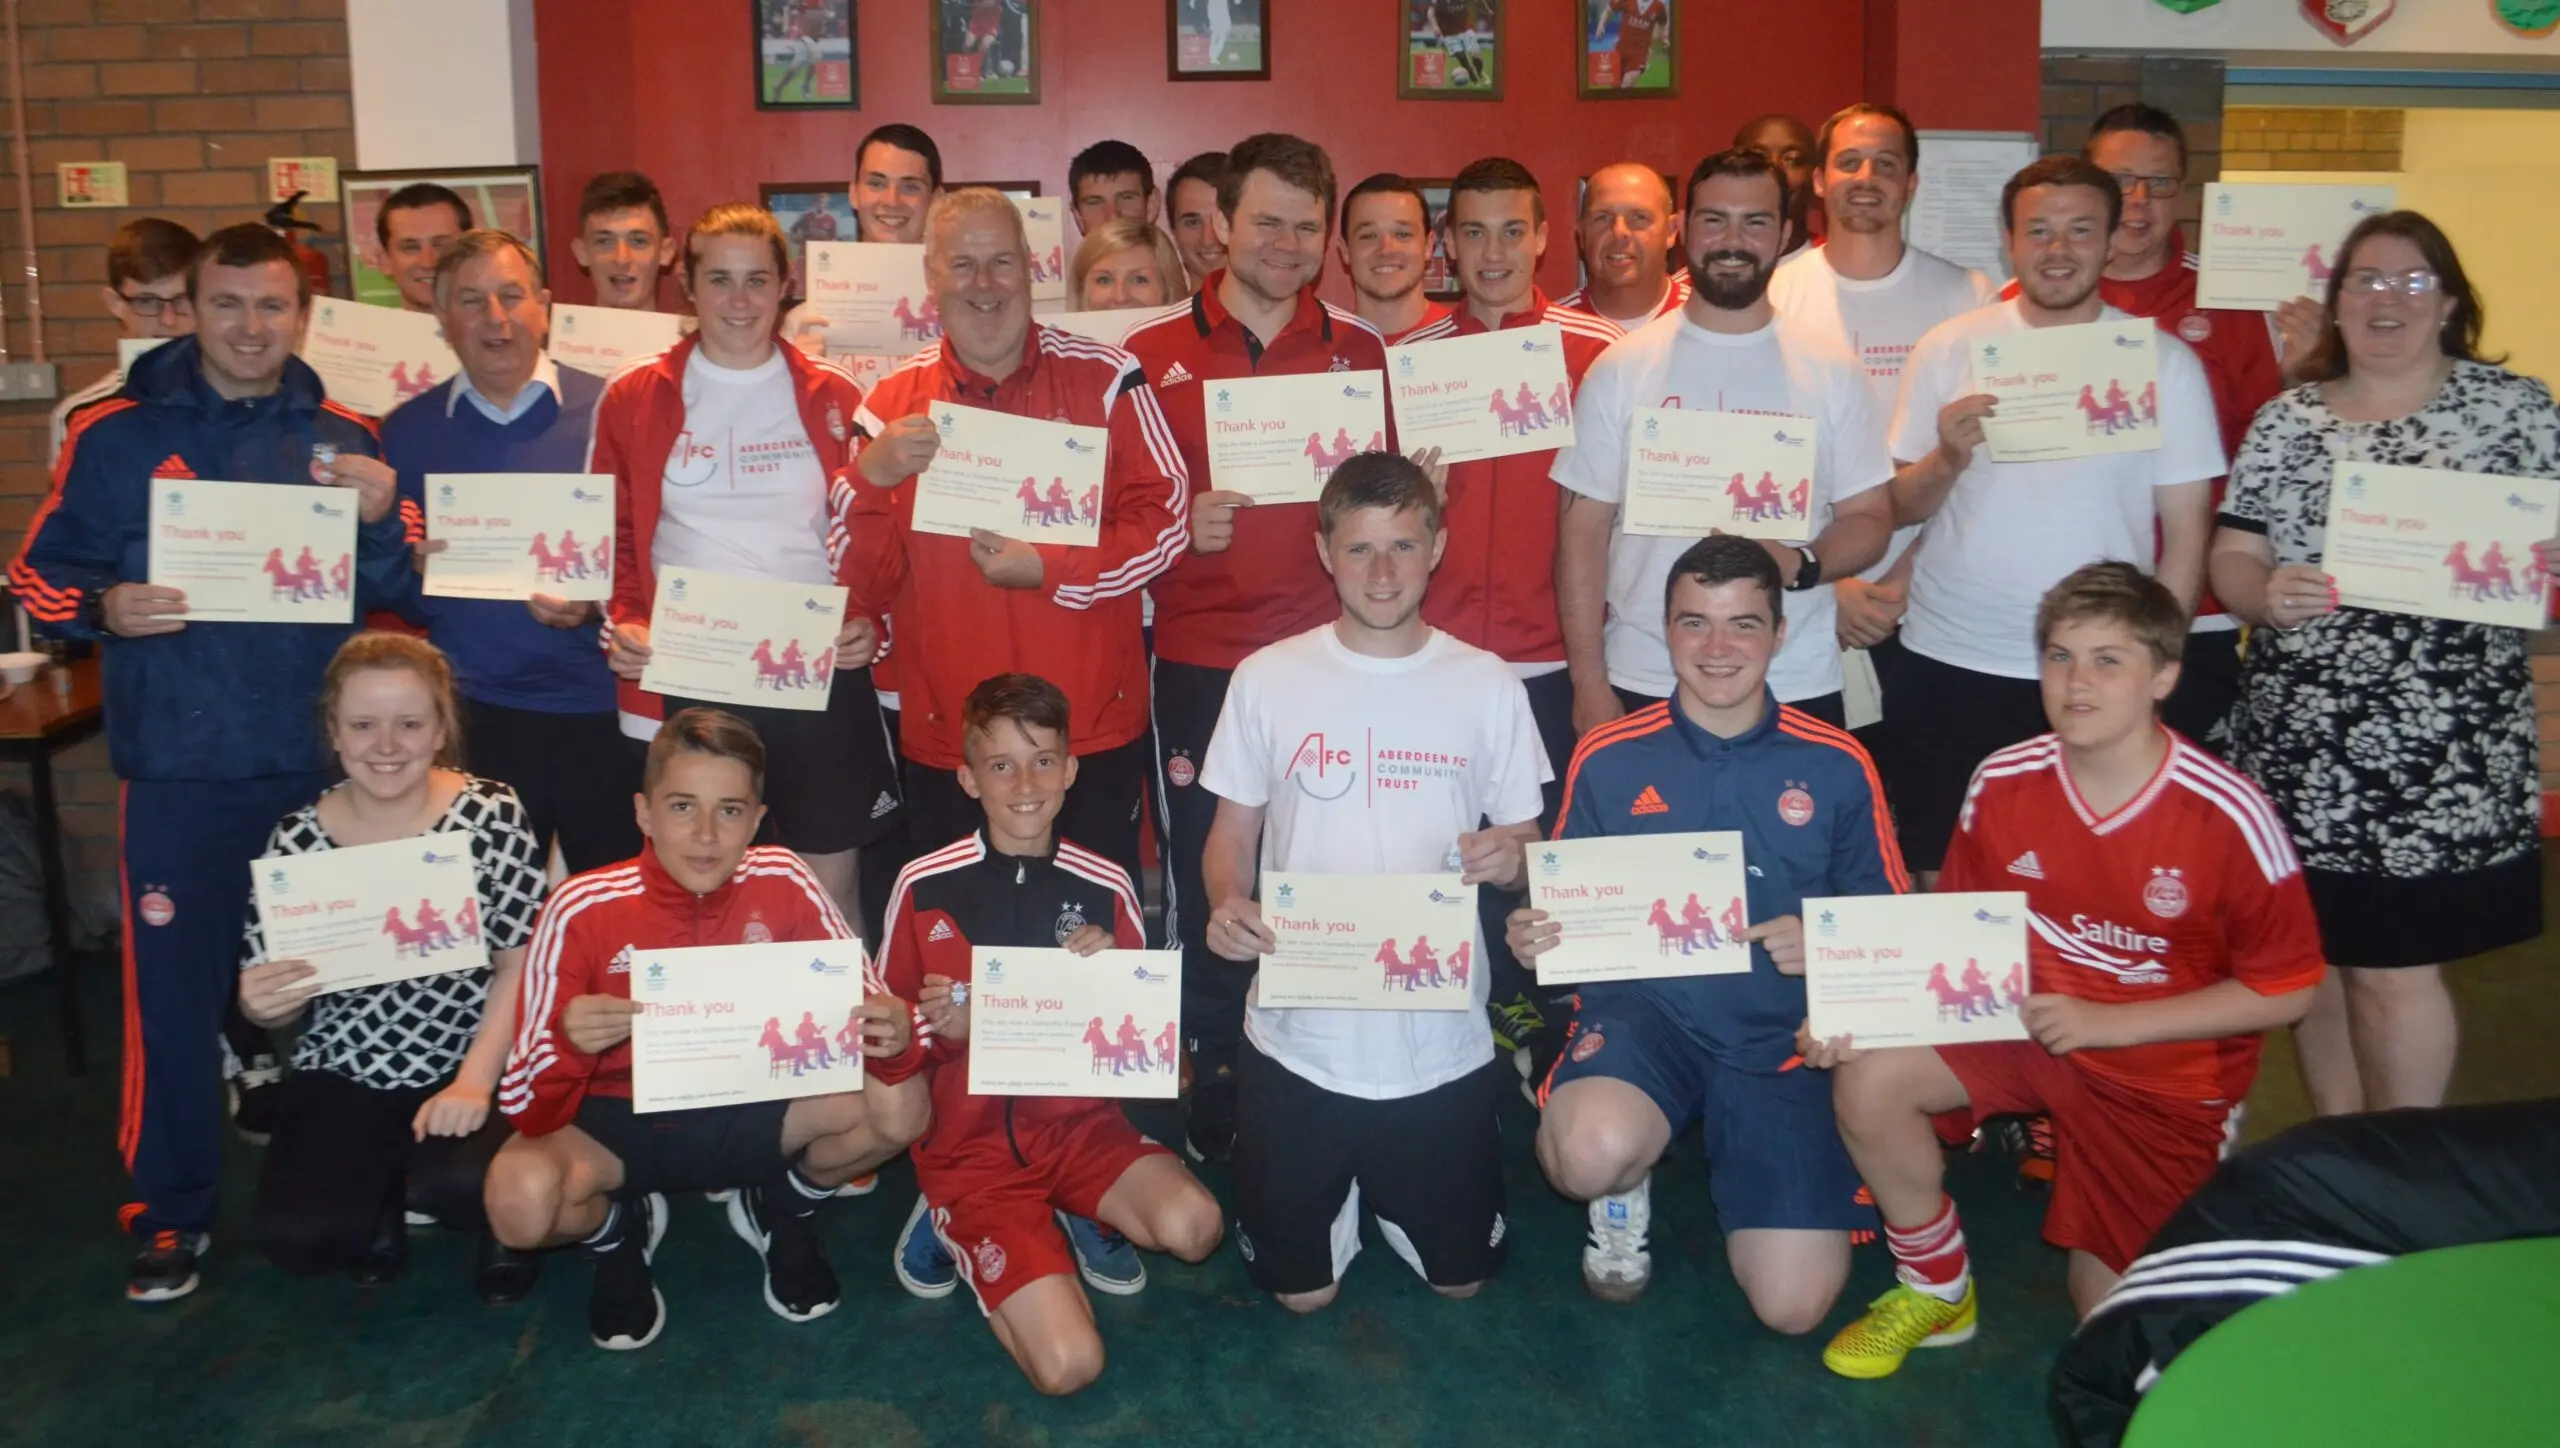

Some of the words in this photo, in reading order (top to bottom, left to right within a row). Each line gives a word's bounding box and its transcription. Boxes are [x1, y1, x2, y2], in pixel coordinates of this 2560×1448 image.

[2212, 222, 2254, 238] Thank
[2258, 227, 2286, 241] you
[815, 278, 851, 292] Thank
[856, 281, 878, 295] you
[1160, 373, 1193, 387] adidas
[1399, 381, 1440, 399] Thank
[1444, 379, 1468, 394] you
[1982, 371, 2027, 389] Thank
[2031, 371, 2059, 388] you
[1215, 418, 1257, 434] Thank
[1261, 419, 1286, 435] you
[938, 446, 972, 463] hank
[977, 453, 1003, 468] you
[1638, 447, 1680, 464] Thank
[1684, 453, 1711, 467] you
[740, 462, 781, 474] TRUST
[436, 514, 480, 528] Thank
[485, 517, 512, 530] you
[2340, 507, 2388, 527] Thank
[2396, 516, 2429, 532] you
[160, 524, 210, 541] Thank
[215, 528, 246, 544] you
[663, 606, 706, 625] Thank
[711, 617, 740, 631] you
[1377, 749, 1449, 764] ABERDEEN
[1452, 756, 1468, 768] FC
[1376, 763, 1462, 780] COMMUNITY
[1377, 778, 1419, 790] TRUST
[1540, 884, 1589, 900] Thank
[1594, 884, 1624, 900] you
[270, 898, 320, 920] Thank
[325, 897, 357, 916] you
[1272, 915, 1320, 932] Thank
[1326, 919, 1356, 935] you
[2071, 914, 2169, 954] Saltire
[928, 931, 955, 942] adidas
[1816, 946, 1867, 962] Thank
[1871, 947, 1904, 963] you
[644, 1000, 697, 1018] Thank
[703, 1000, 735, 1019] you
[982, 993, 1029, 1010] Thank
[1035, 997, 1063, 1013] you
